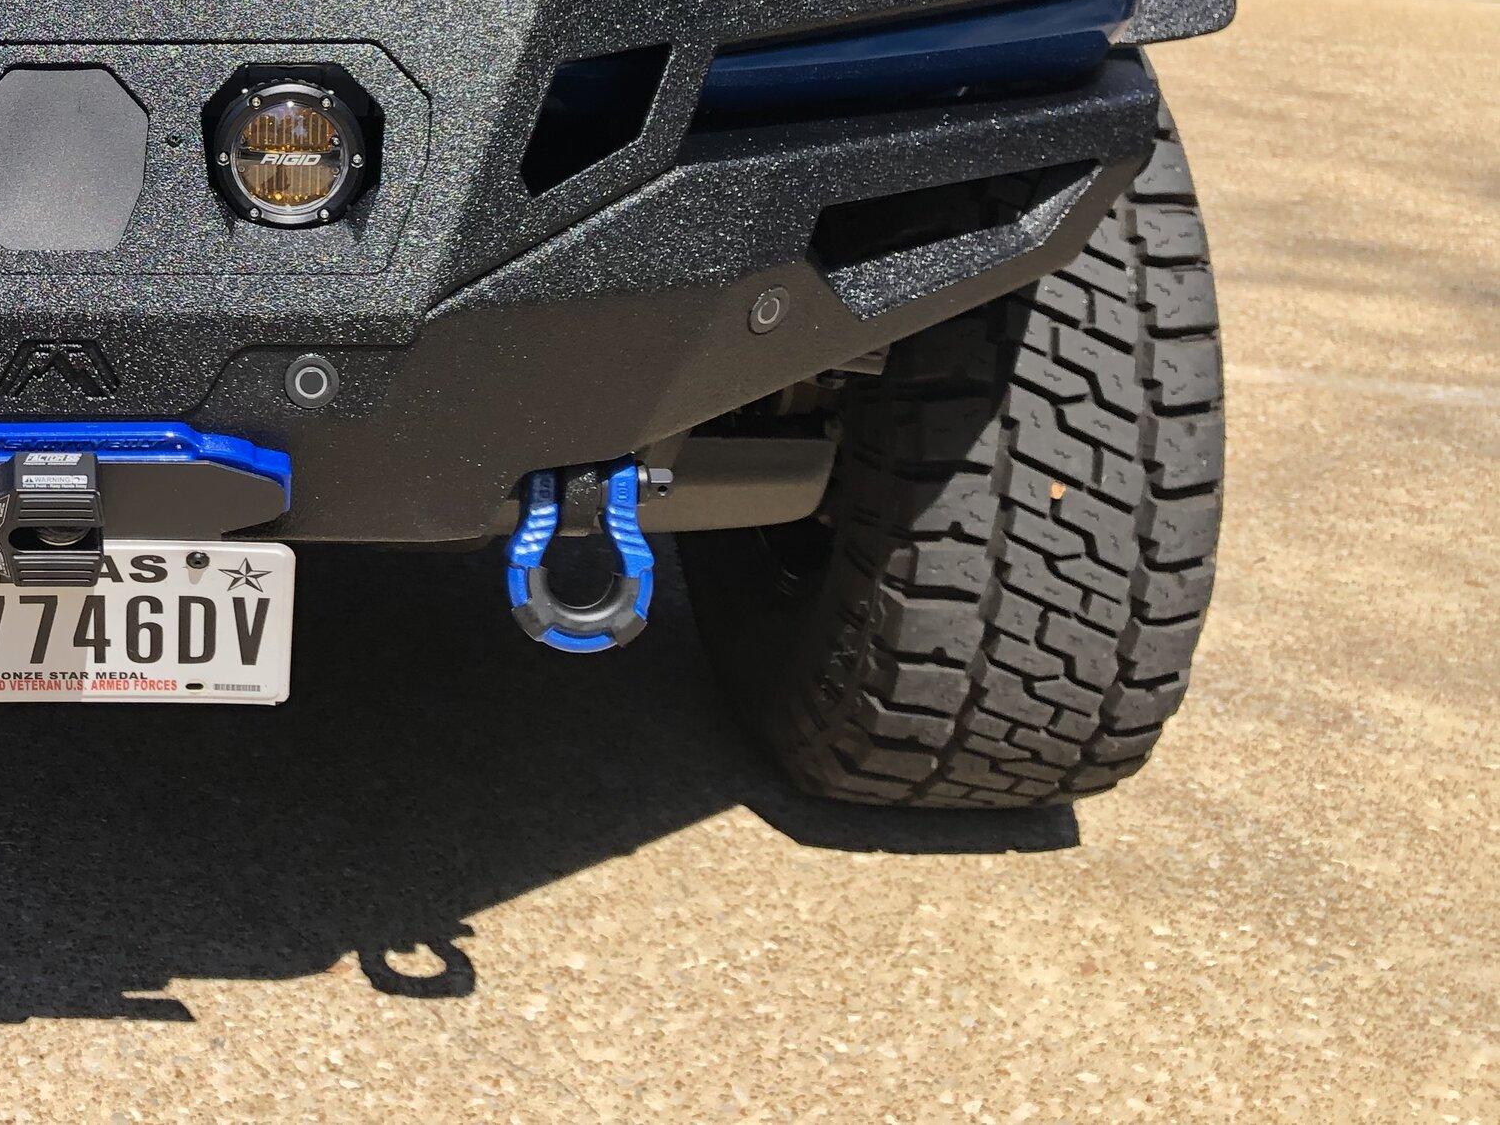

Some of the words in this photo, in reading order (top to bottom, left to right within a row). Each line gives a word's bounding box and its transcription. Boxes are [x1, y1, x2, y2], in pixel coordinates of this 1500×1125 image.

[260, 153, 322, 166] RIGID
[49, 671, 89, 680] STAR
[95, 671, 148, 680] MEDAL
[10, 680, 62, 691] VETERAN
[66, 680, 88, 691] U.S.
[91, 680, 130, 691] ARMED
[133, 680, 178, 691] FORCES
